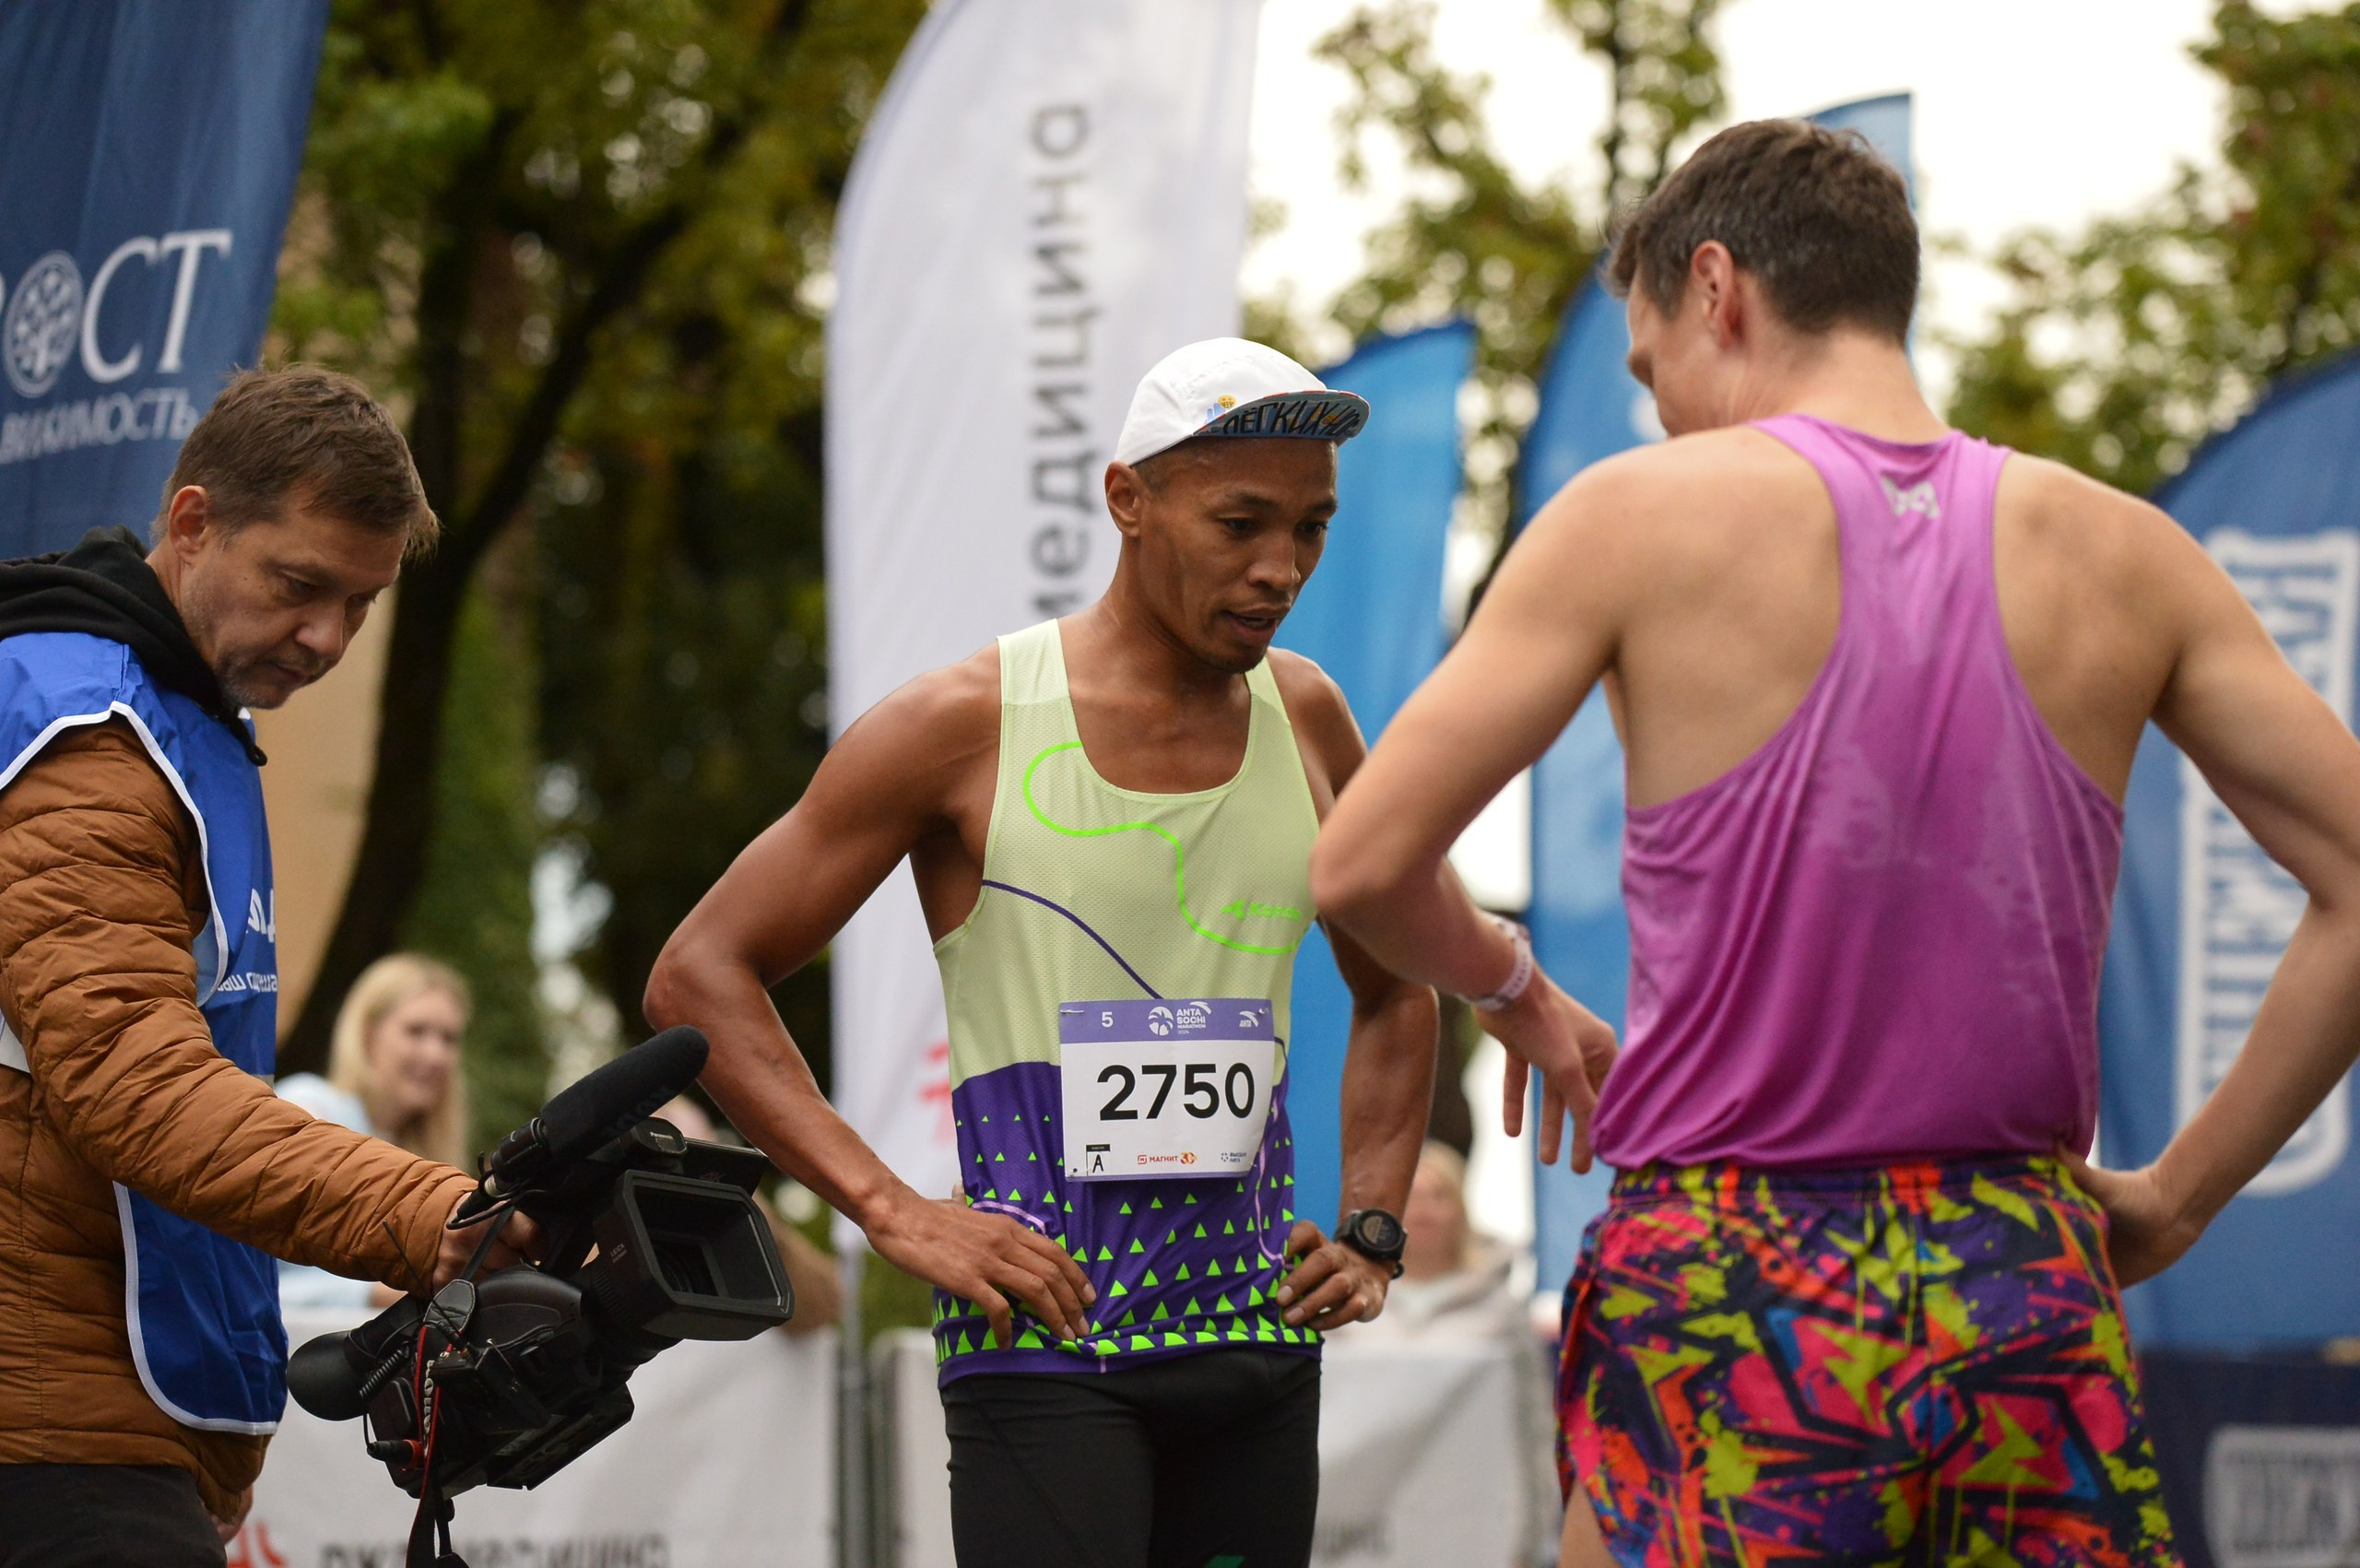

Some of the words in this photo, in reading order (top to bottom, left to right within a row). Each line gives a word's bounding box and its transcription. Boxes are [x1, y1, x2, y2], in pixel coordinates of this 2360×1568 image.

[1102, 1011, 1114, 1028] 5
[1176, 1016, 1206, 1024] SOCHI
[1097, 1062, 1255, 1121] 2750
[1092, 1153, 1104, 1173] A
